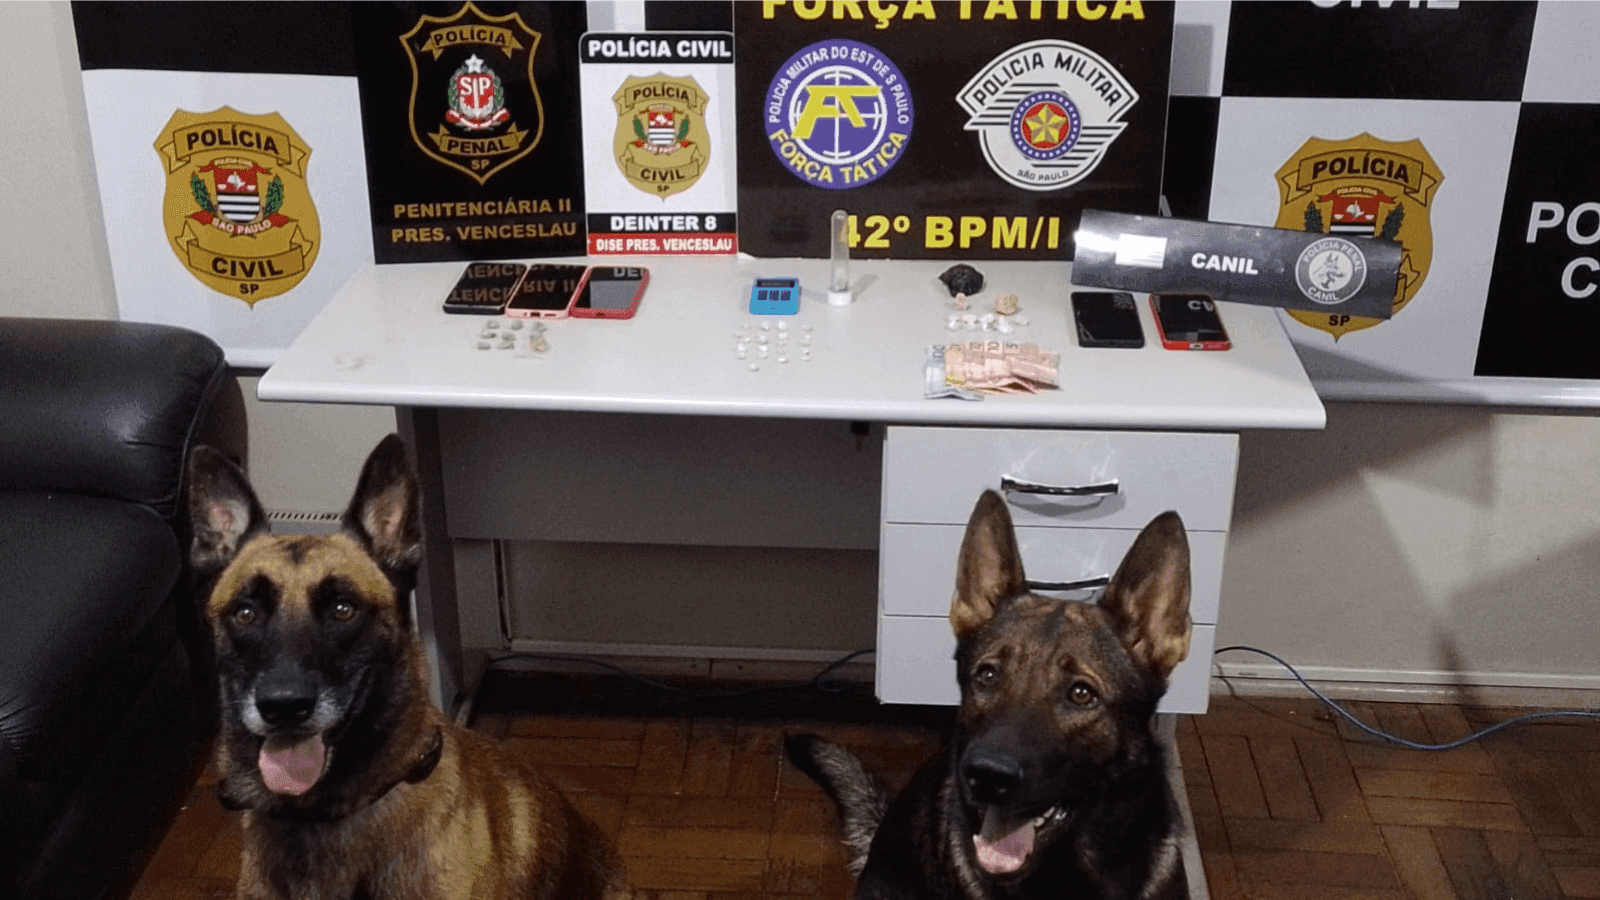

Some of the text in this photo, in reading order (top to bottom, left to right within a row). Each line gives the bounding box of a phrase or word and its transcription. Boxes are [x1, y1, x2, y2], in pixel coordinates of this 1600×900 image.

[588, 37, 732, 57] POLÍCIA CIVIL
[831, 45, 849, 60] DO
[785, 47, 830, 80] MILITAR
[850, 47, 875, 67] EST
[872, 59, 891, 78] DE
[885, 73, 897, 86] S
[972, 52, 1123, 107] POLICIA MILITAR
[633, 82, 690, 101] POLÍCIA
[890, 84, 910, 124] PAULO
[186, 124, 279, 155] POLÍCIA
[447, 138, 511, 154] PENAL
[471, 159, 490, 170] SP
[1312, 152, 1409, 184] POLÍCIA
[640, 168, 685, 182] CIVIL
[1038, 169, 1070, 182] PAULO
[657, 184, 670, 193] SP
[394, 197, 572, 218] PENITENCIÁRIA II
[610, 215, 717, 231] DEINTER 8
[925, 216, 1060, 249] BPM/I
[392, 223, 577, 243] PRES. VENCESLAU
[596, 238, 732, 252] DISE PRES. VENCESLAU
[212, 257, 284, 278] CIVIL
[1191, 252, 1259, 275] CANIL
[1341, 243, 1362, 273] PENAL
[239, 283, 260, 294] SP
[1308, 286, 1340, 301] CANIL
[1329, 315, 1350, 327] SP
